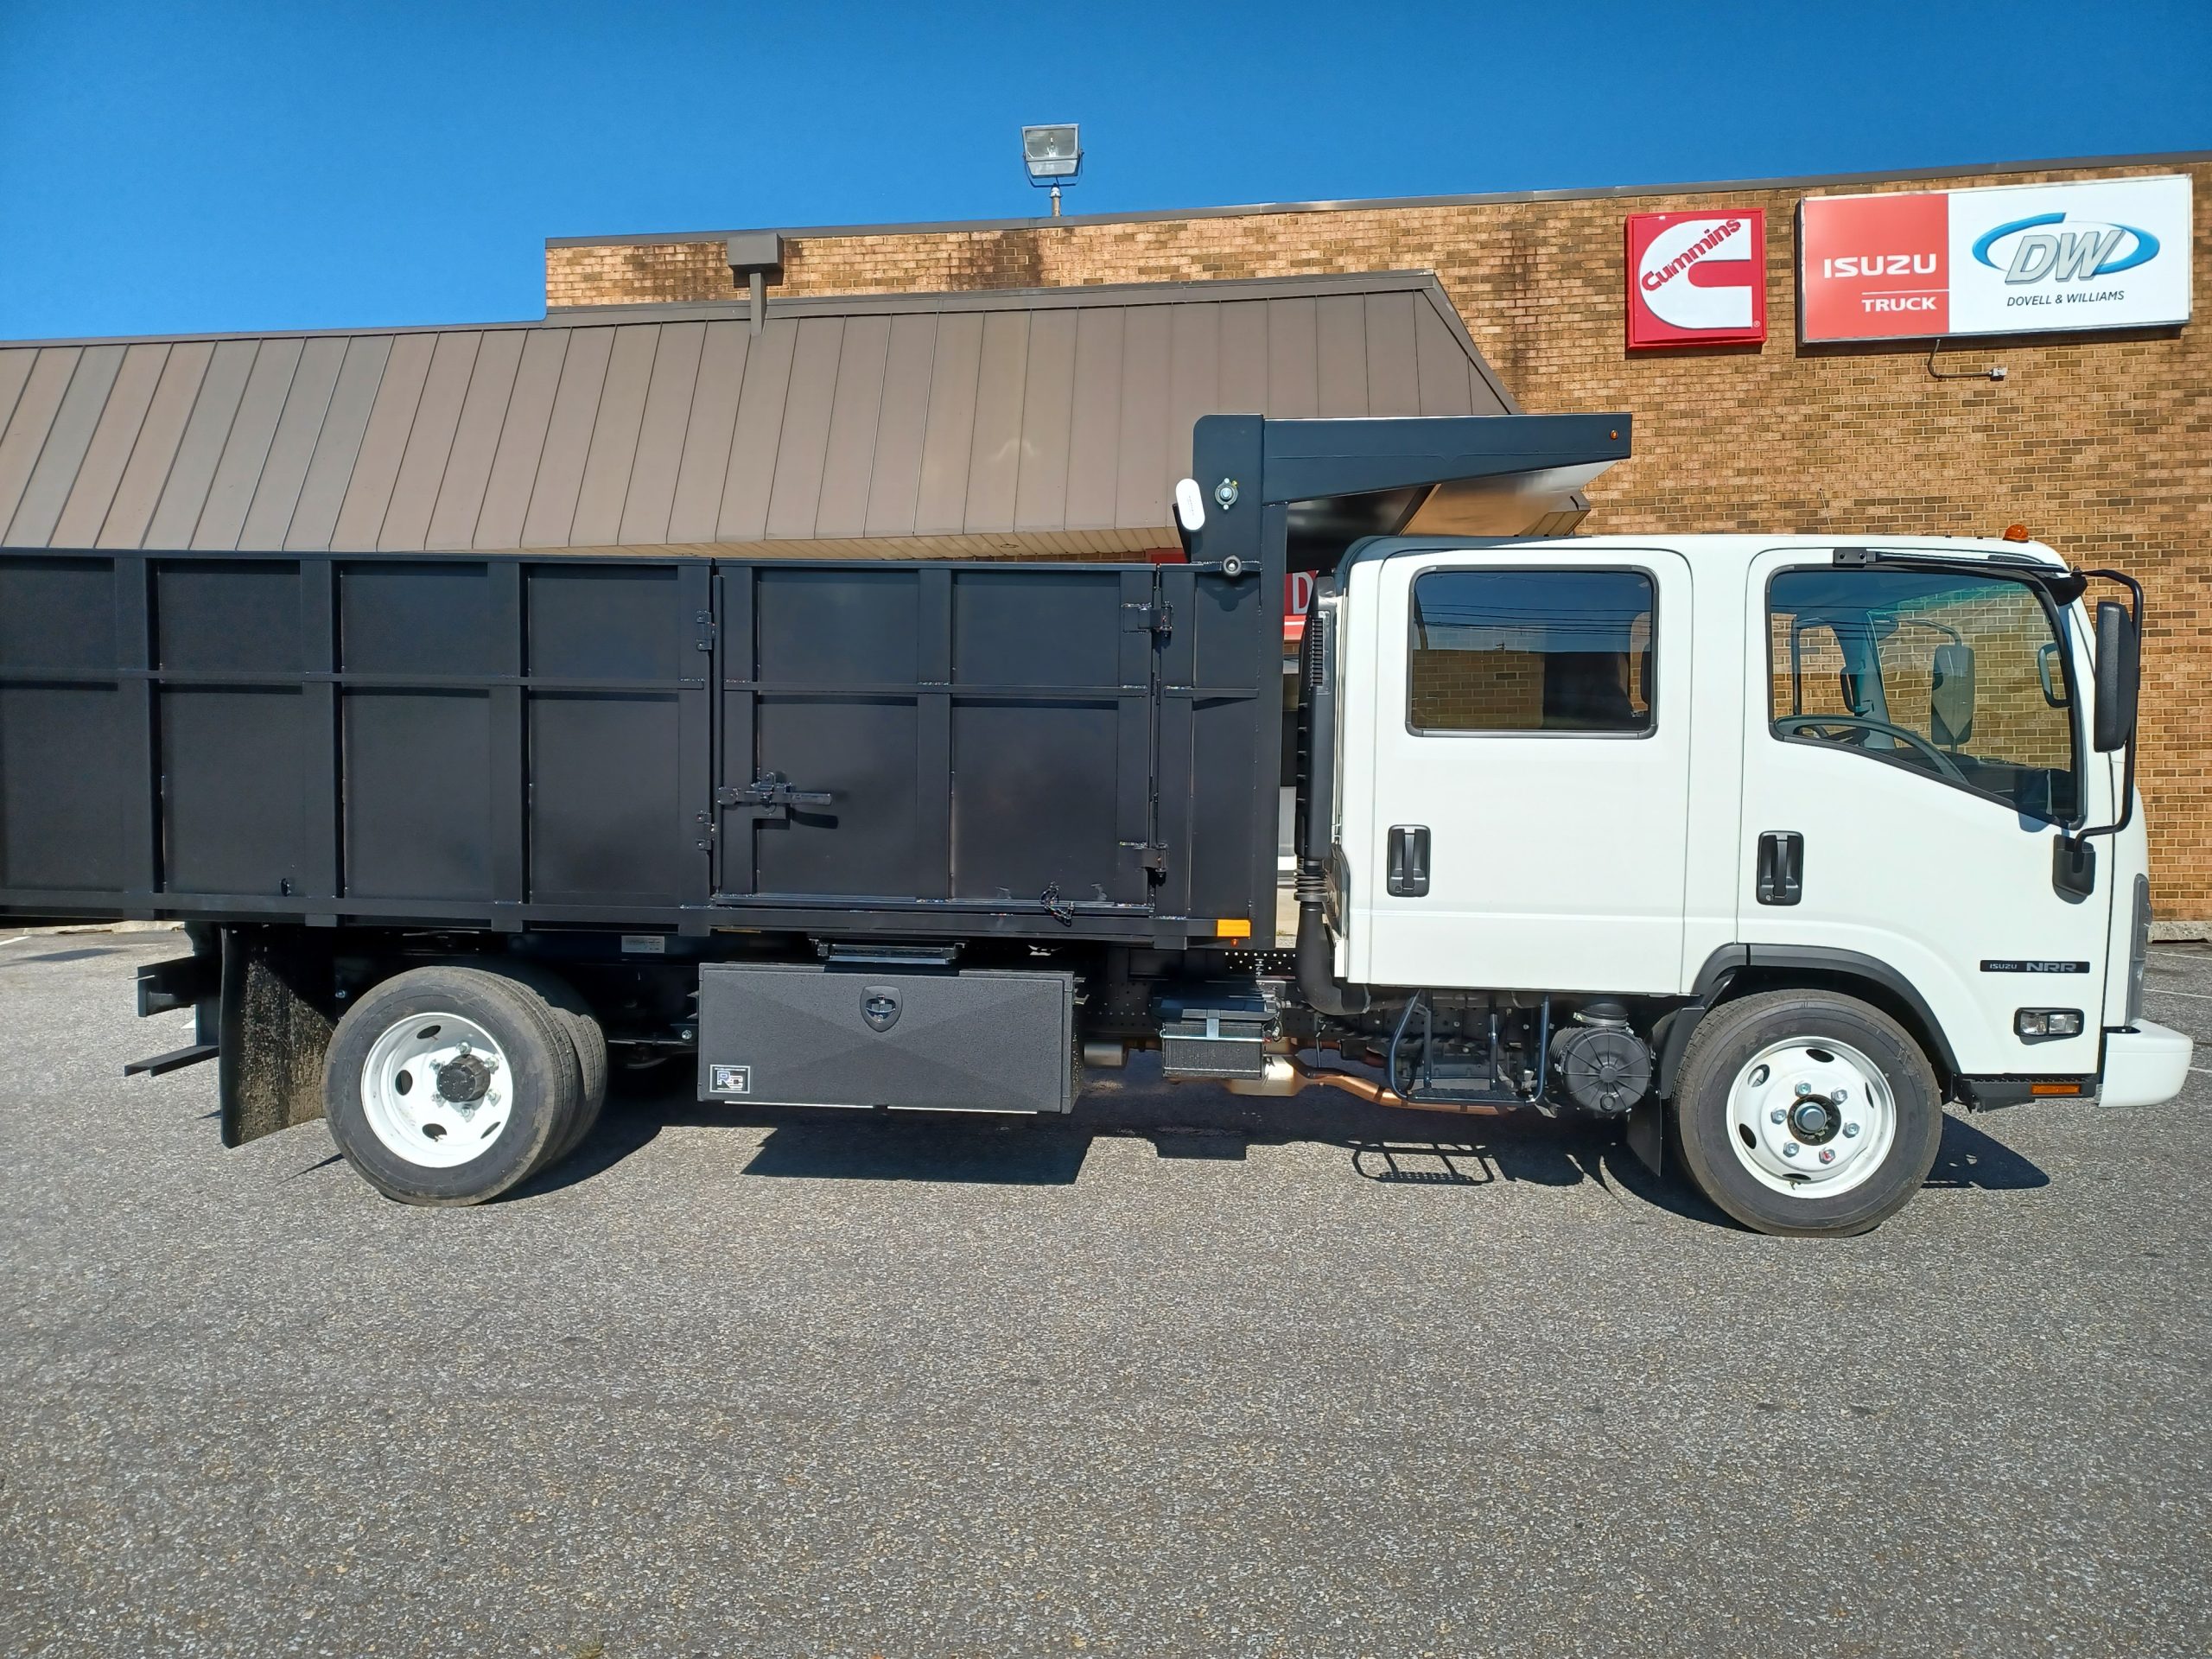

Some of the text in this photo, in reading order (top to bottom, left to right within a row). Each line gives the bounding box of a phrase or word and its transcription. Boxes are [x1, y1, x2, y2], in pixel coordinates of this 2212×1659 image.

[1642, 219, 1741, 291] Cummins
[2005, 229, 2126, 285] DW
[1824, 253, 1937, 279] ISUZU
[1861, 296, 1937, 313] TRUCK
[2006, 290, 2125, 307] DOVELL & WILLIAMS
[2026, 962, 2077, 972] NRR
